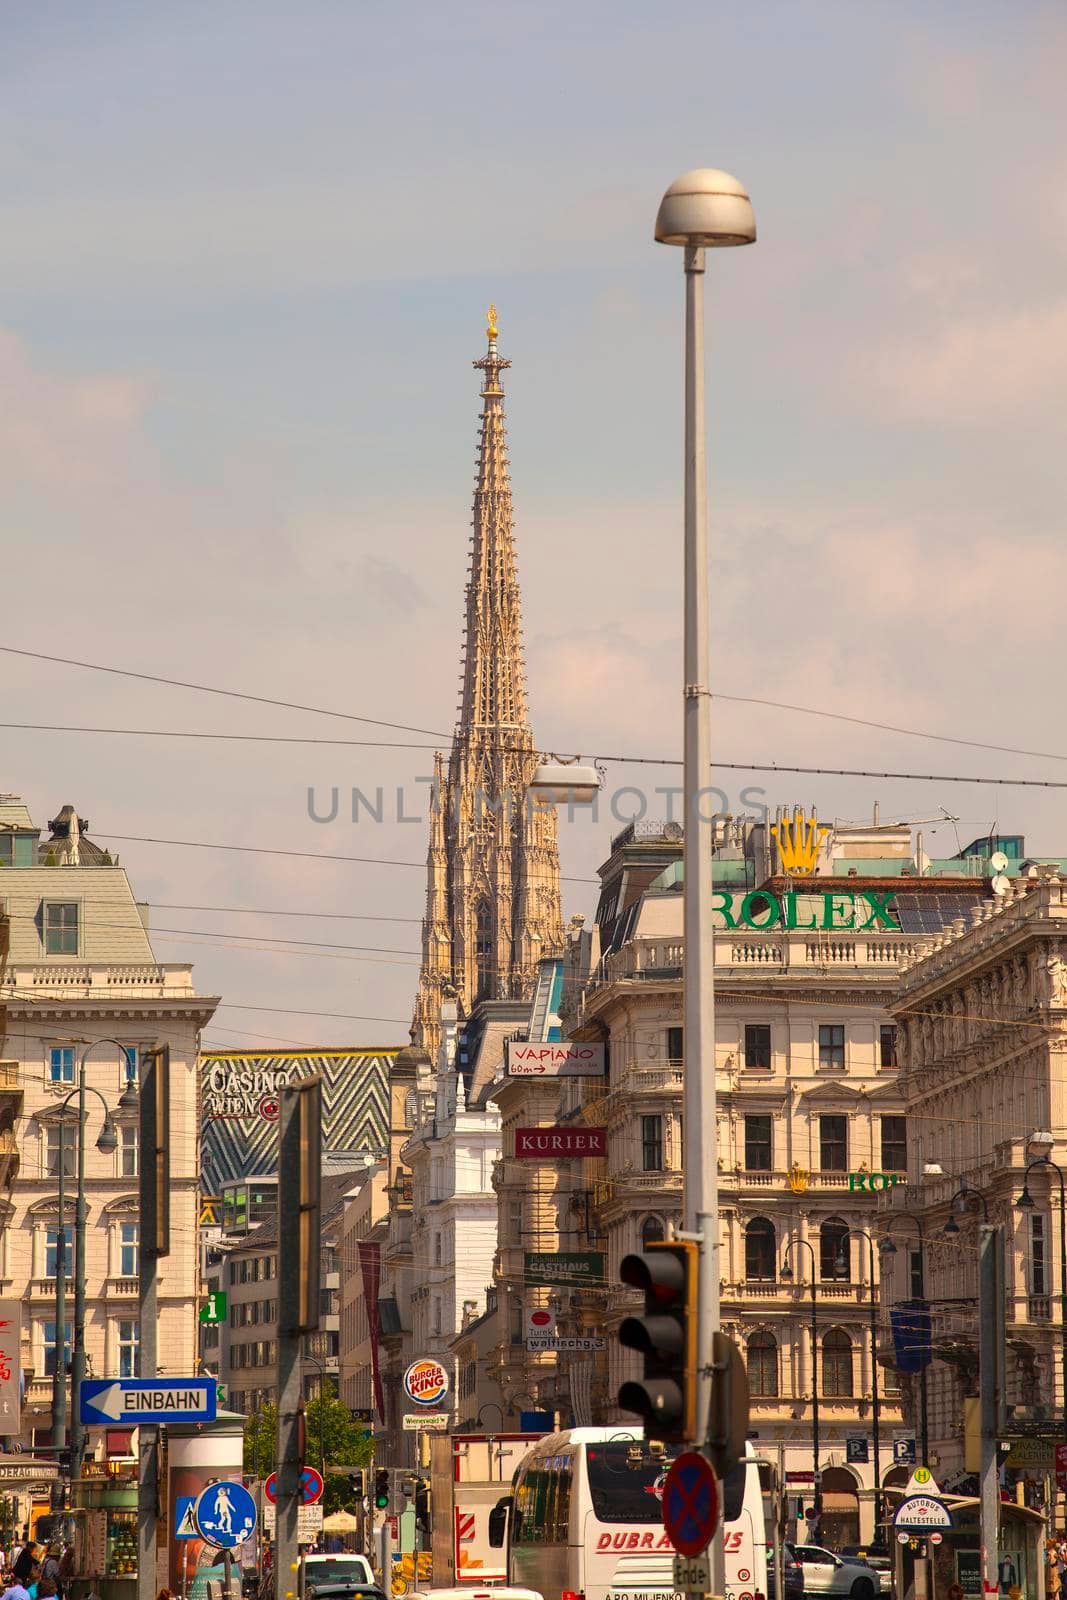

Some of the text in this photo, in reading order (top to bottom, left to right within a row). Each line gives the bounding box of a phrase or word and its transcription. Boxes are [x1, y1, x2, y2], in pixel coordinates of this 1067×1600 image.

[210, 1097, 257, 1115] WIEN
[521, 1135, 601, 1149] KURIER
[530, 1262, 590, 1272] GASTHAUS
[409, 1367, 442, 1385] BURGER
[411, 1375, 444, 1395] KING
[124, 1391, 200, 1410] EINBAHN
[906, 1500, 940, 1512] AUTOBUS
[901, 1517, 945, 1525] HALTESTELLE
